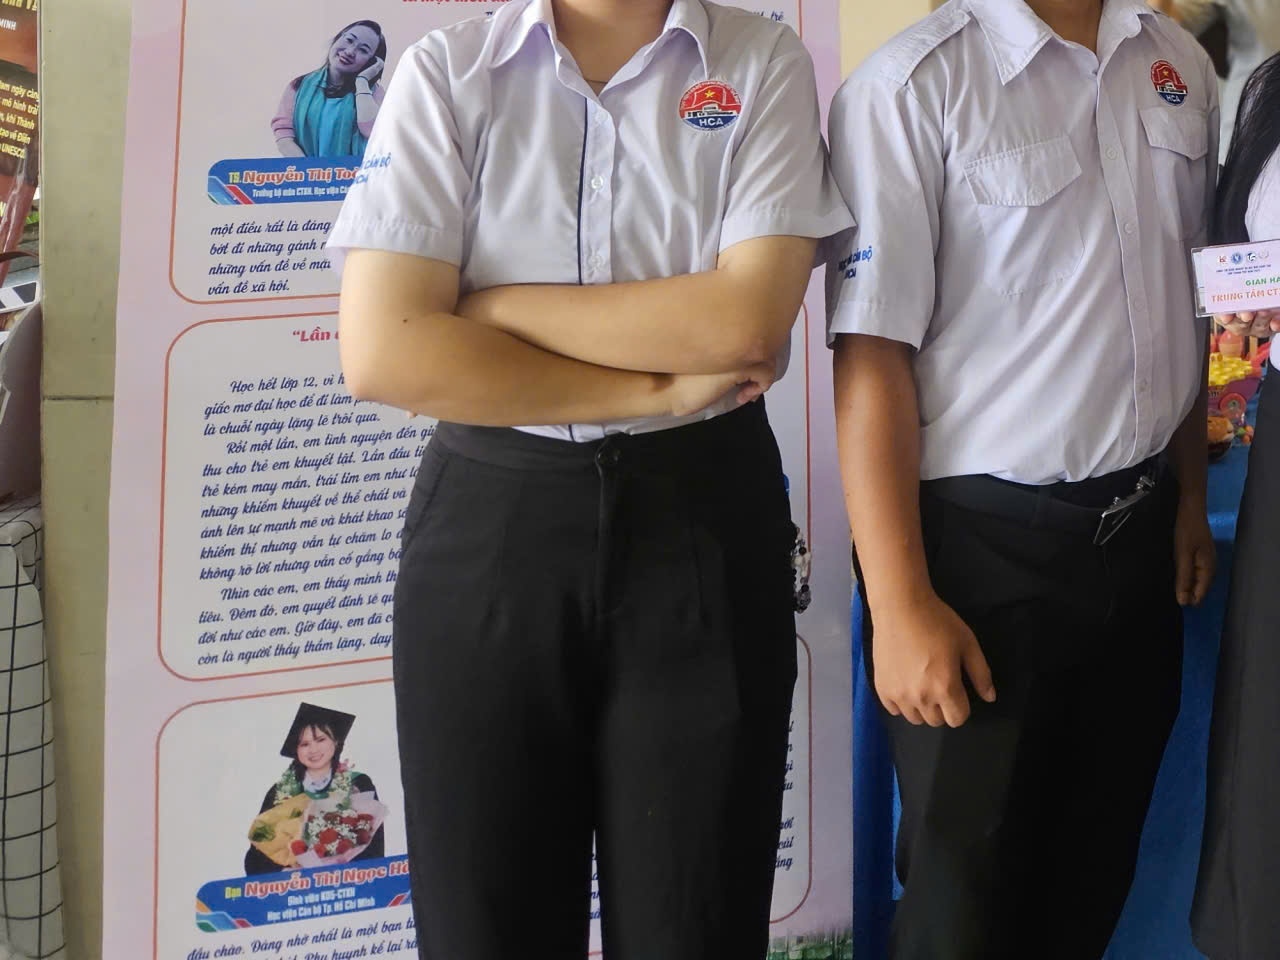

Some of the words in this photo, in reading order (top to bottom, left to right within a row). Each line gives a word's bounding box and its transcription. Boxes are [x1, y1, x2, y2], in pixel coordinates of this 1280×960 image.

[699, 117, 723, 126] HCA
[243, 166, 303, 185] Nguyễn
[307, 168, 331, 182] Thị
[211, 222, 233, 236] một
[236, 221, 261, 234] điều
[265, 220, 283, 233] rất
[287, 220, 298, 232] là
[302, 220, 332, 235] đáng
[210, 242, 228, 255] bớt
[231, 241, 245, 254] đi
[247, 240, 283, 256] những
[287, 238, 316, 256] gánh
[207, 282, 230, 296] vấn
[233, 280, 248, 294] đề
[250, 281, 265, 293] xã
[268, 279, 290, 293] hội.
[1211, 292, 1243, 303] TRUNG
[230, 379, 254, 393] Học
[258, 376, 277, 391] hết
[280, 376, 299, 392] lớp
[323, 373, 335, 386] vì
[204, 402, 231, 420] giấc
[233, 401, 253, 413] mơ
[254, 397, 273, 413] đại
[276, 397, 297, 412] học
[316, 394, 329, 407] đi
[330, 393, 352, 406] làm
[203, 422, 216, 436] là
[218, 419, 251, 435] chuỗi
[254, 418, 284, 435] ngày
[288, 414, 313, 431] lặng
[318, 413, 329, 426] lẽ
[331, 412, 352, 425] trôi
[355, 412, 380, 426] qua.
[244, 873, 310, 898] Nguyễn
[313, 872, 342, 889] Thị
[343, 866, 386, 886] Ngọc
